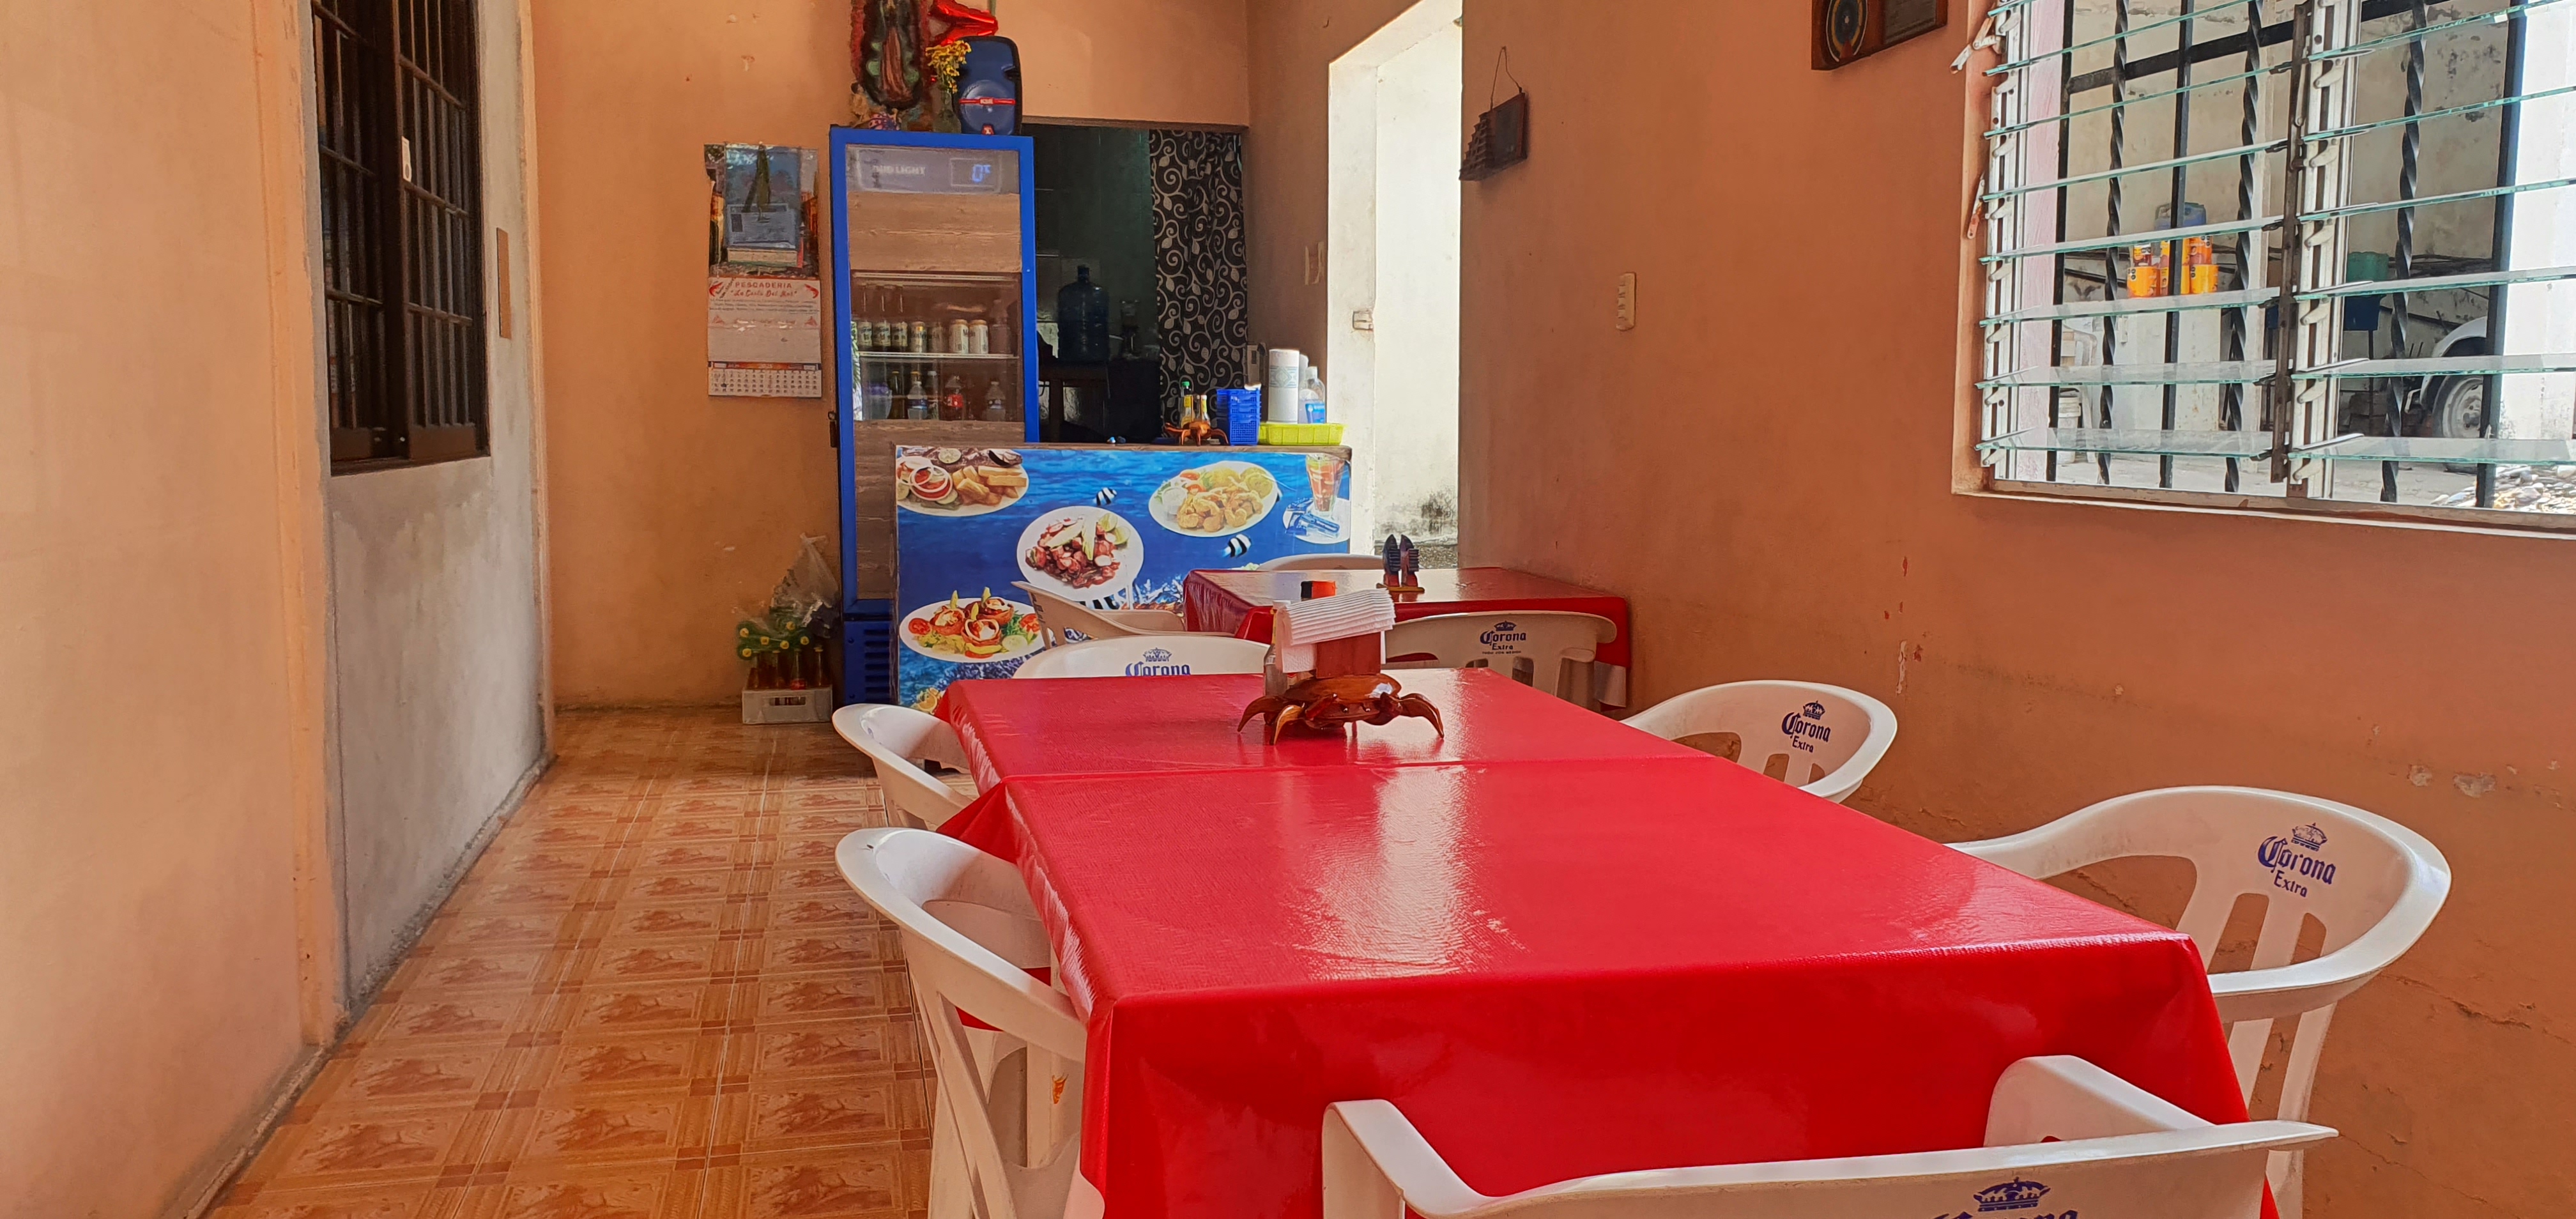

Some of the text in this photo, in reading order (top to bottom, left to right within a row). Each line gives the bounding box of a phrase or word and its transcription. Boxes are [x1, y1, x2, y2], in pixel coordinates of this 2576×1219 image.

[895, 165, 926, 176] LIGHT
[1479, 630, 1526, 646] Corona
[1125, 661, 1191, 677] Corona
[1781, 712, 1831, 742] Corona
[1792, 735, 1814, 753] Extra
[2257, 836, 2336, 885] Corona
[2274, 870, 2308, 898] Extra
